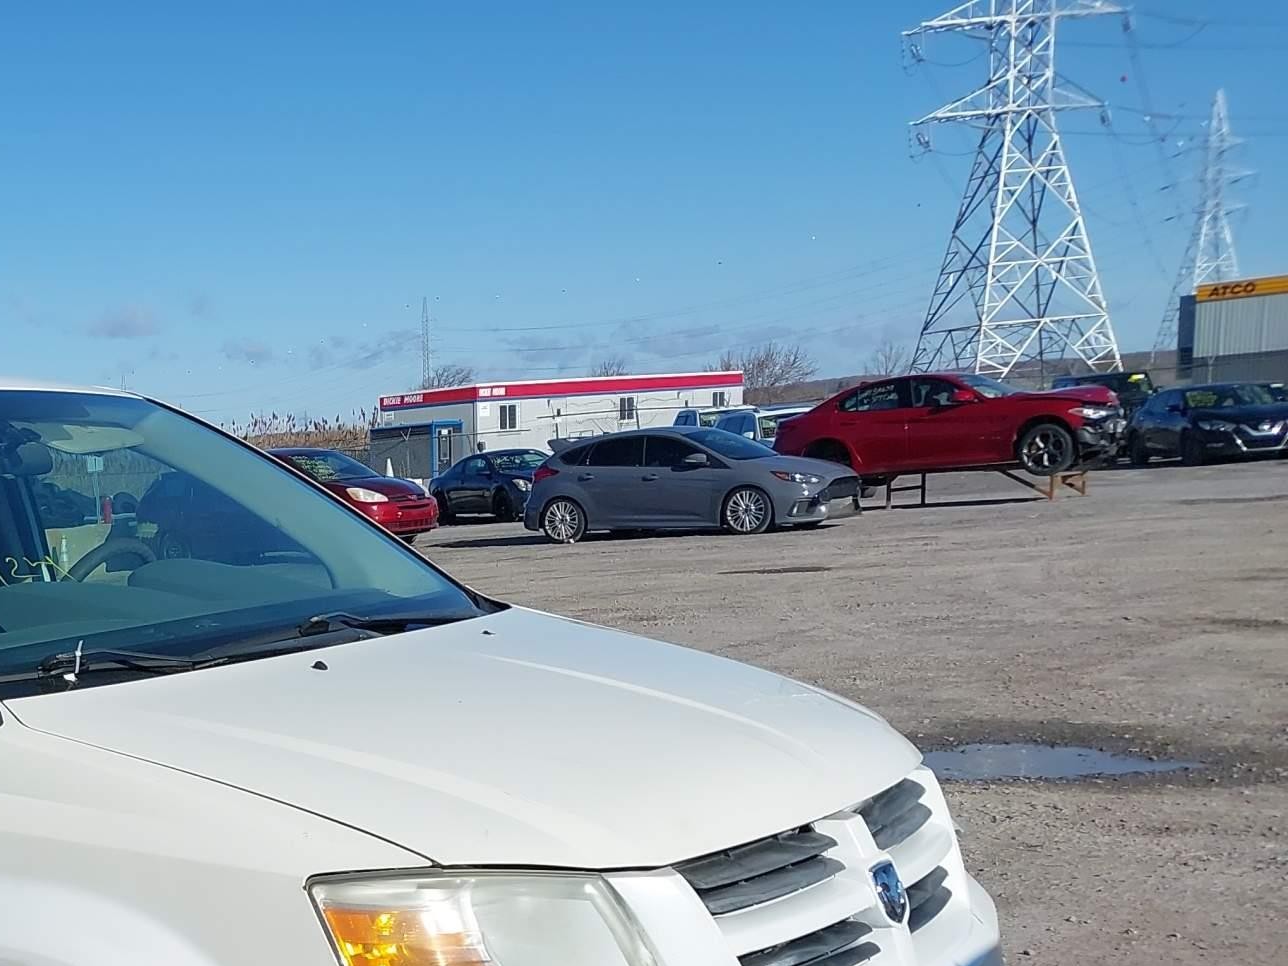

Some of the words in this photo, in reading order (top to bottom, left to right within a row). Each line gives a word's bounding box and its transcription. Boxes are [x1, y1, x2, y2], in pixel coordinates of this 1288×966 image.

[1207, 282, 1256, 298] ATCO
[383, 396, 401, 406] DICKIE
[403, 394, 424, 404] MOORE
